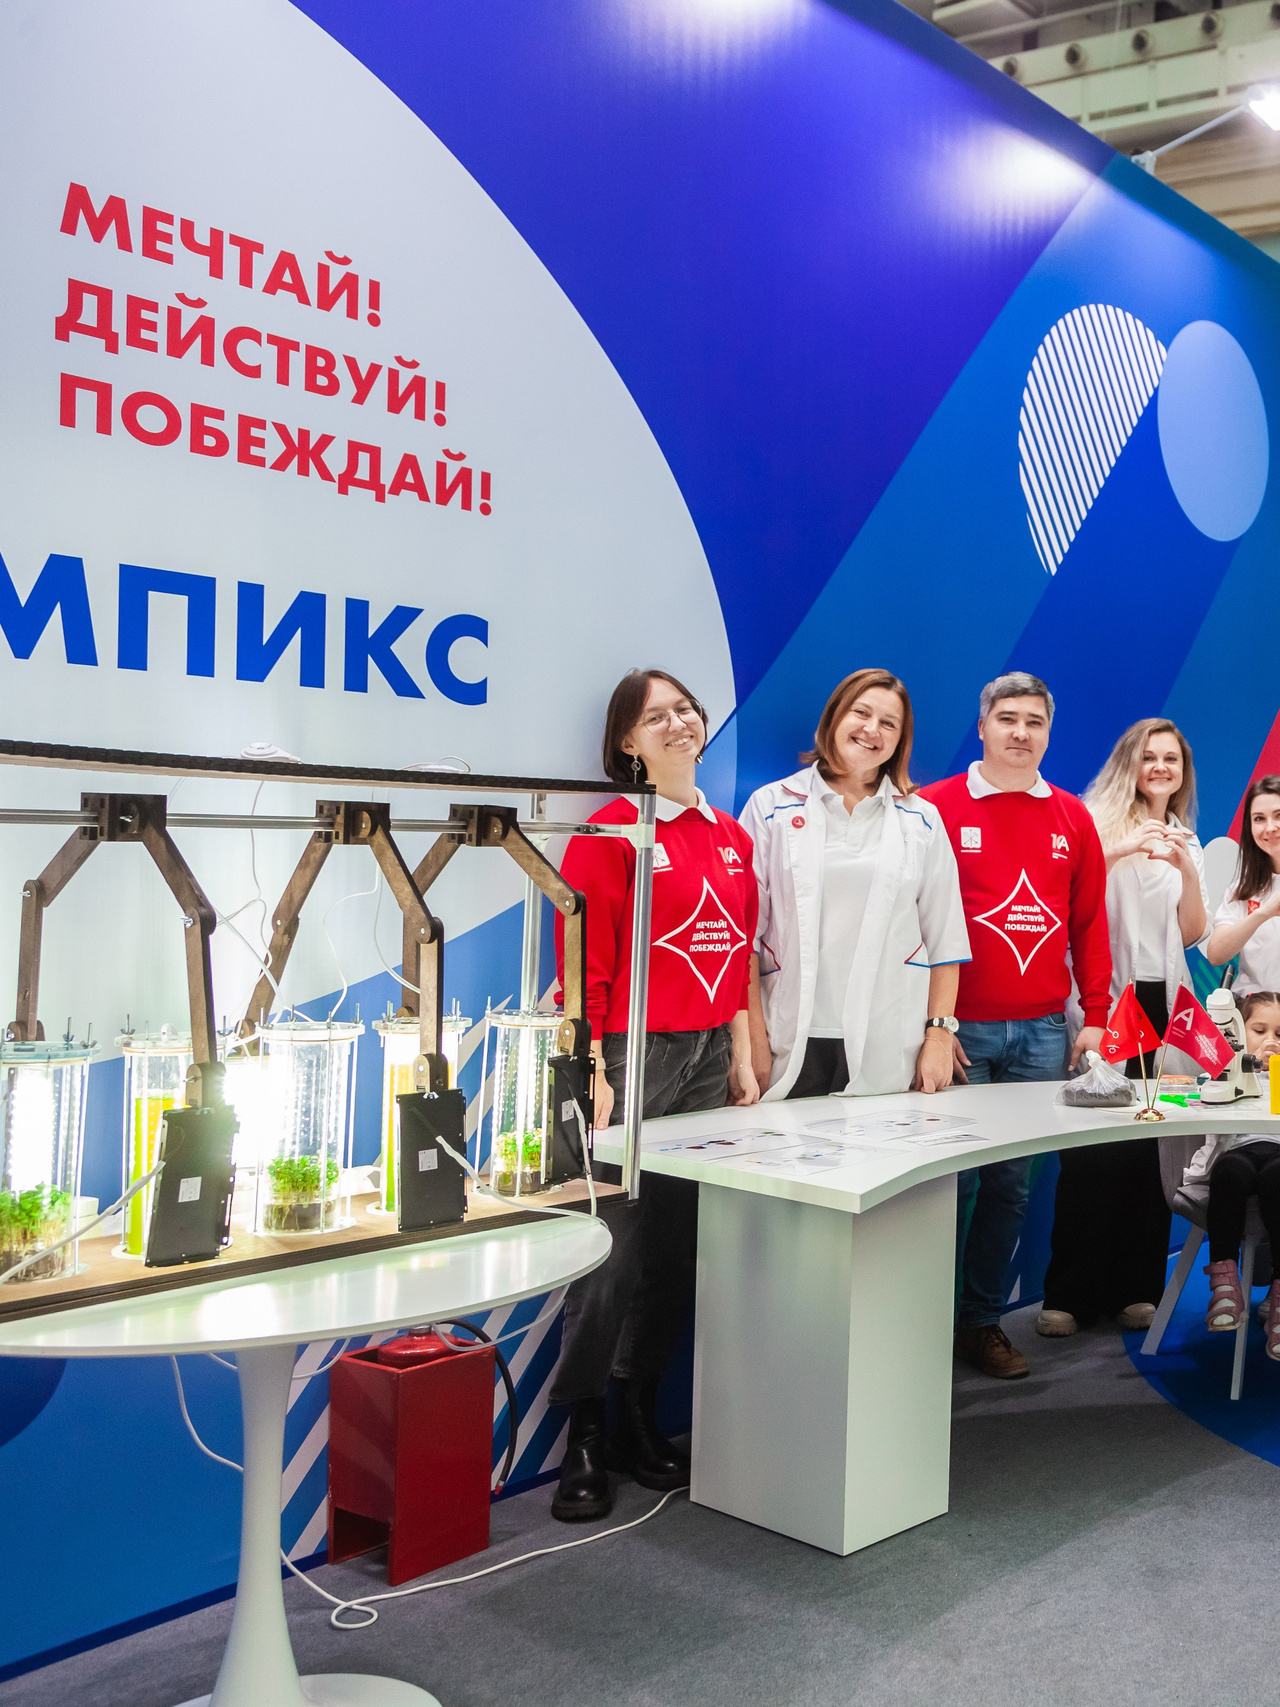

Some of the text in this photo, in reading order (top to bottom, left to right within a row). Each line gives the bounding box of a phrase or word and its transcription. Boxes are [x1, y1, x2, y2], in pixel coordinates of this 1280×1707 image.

[59, 181, 381, 327] МЕЧТАЙ!
[54, 277, 448, 427] ДЕЙСТВУЙ!
[59, 372, 493, 516] ПОБЕЖДАЙ!
[1004, 923, 1047, 933] ПОБЕЖДАЙ!
[1007, 913, 1045, 923] ДЕЙСТВУЙ!
[1011, 905, 1041, 913] МЕЧТАЙ!
